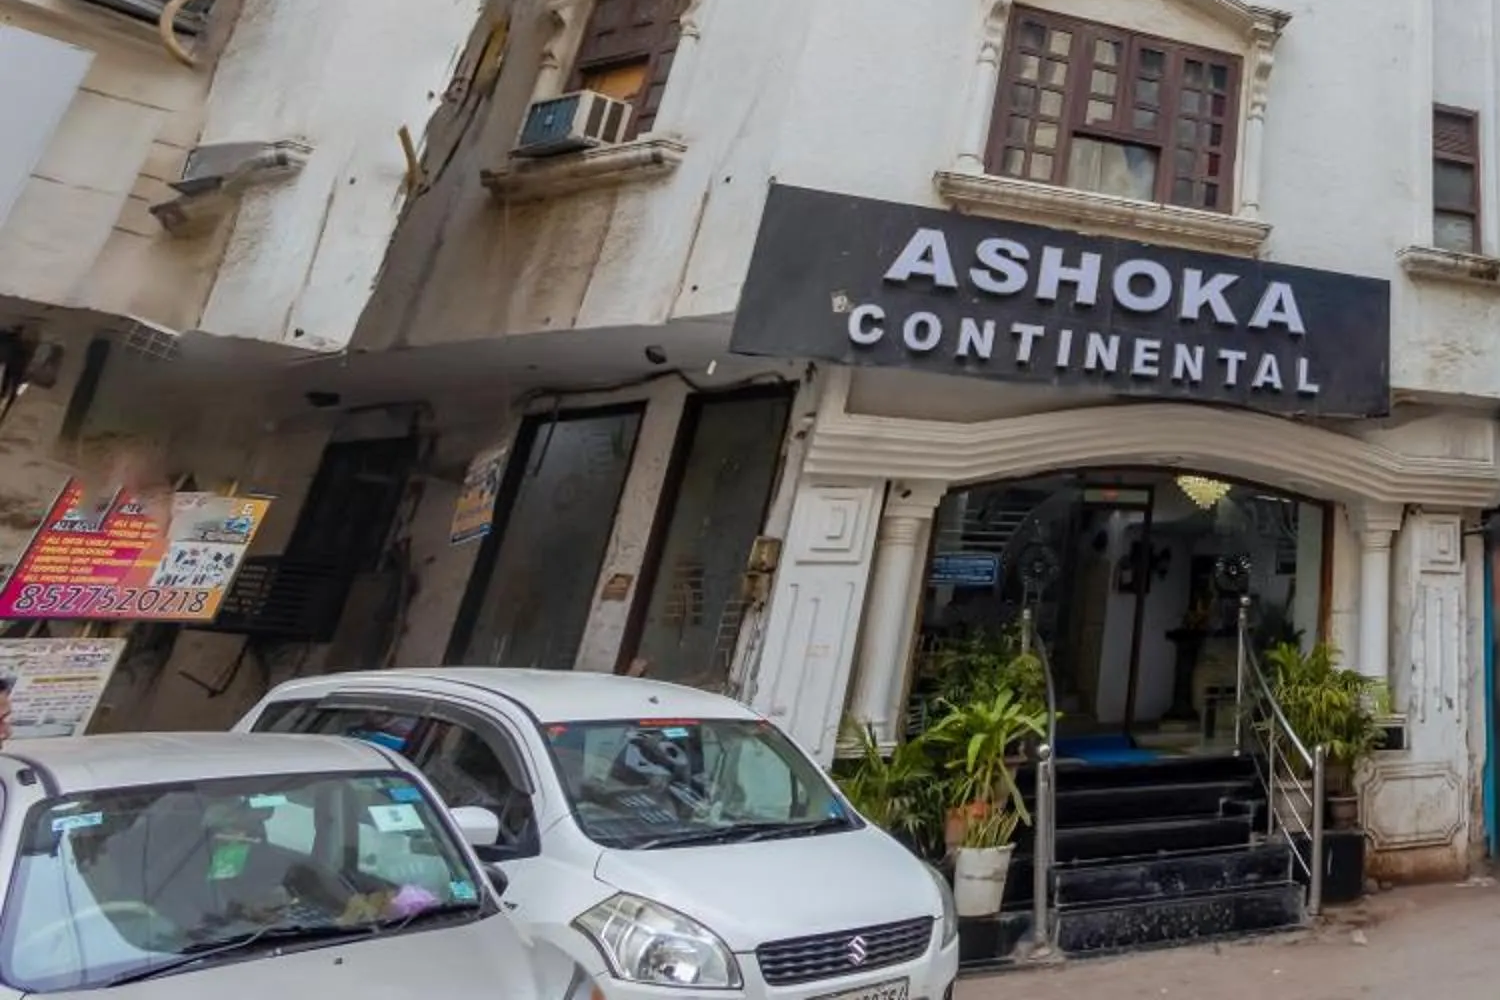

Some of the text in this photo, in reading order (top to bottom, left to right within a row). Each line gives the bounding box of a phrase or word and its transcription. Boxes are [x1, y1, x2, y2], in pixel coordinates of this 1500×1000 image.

[883, 227, 1306, 335] ASHOKA
[846, 303, 1321, 394] CONTINENTAL
[14, 583, 210, 614] 8527520218
